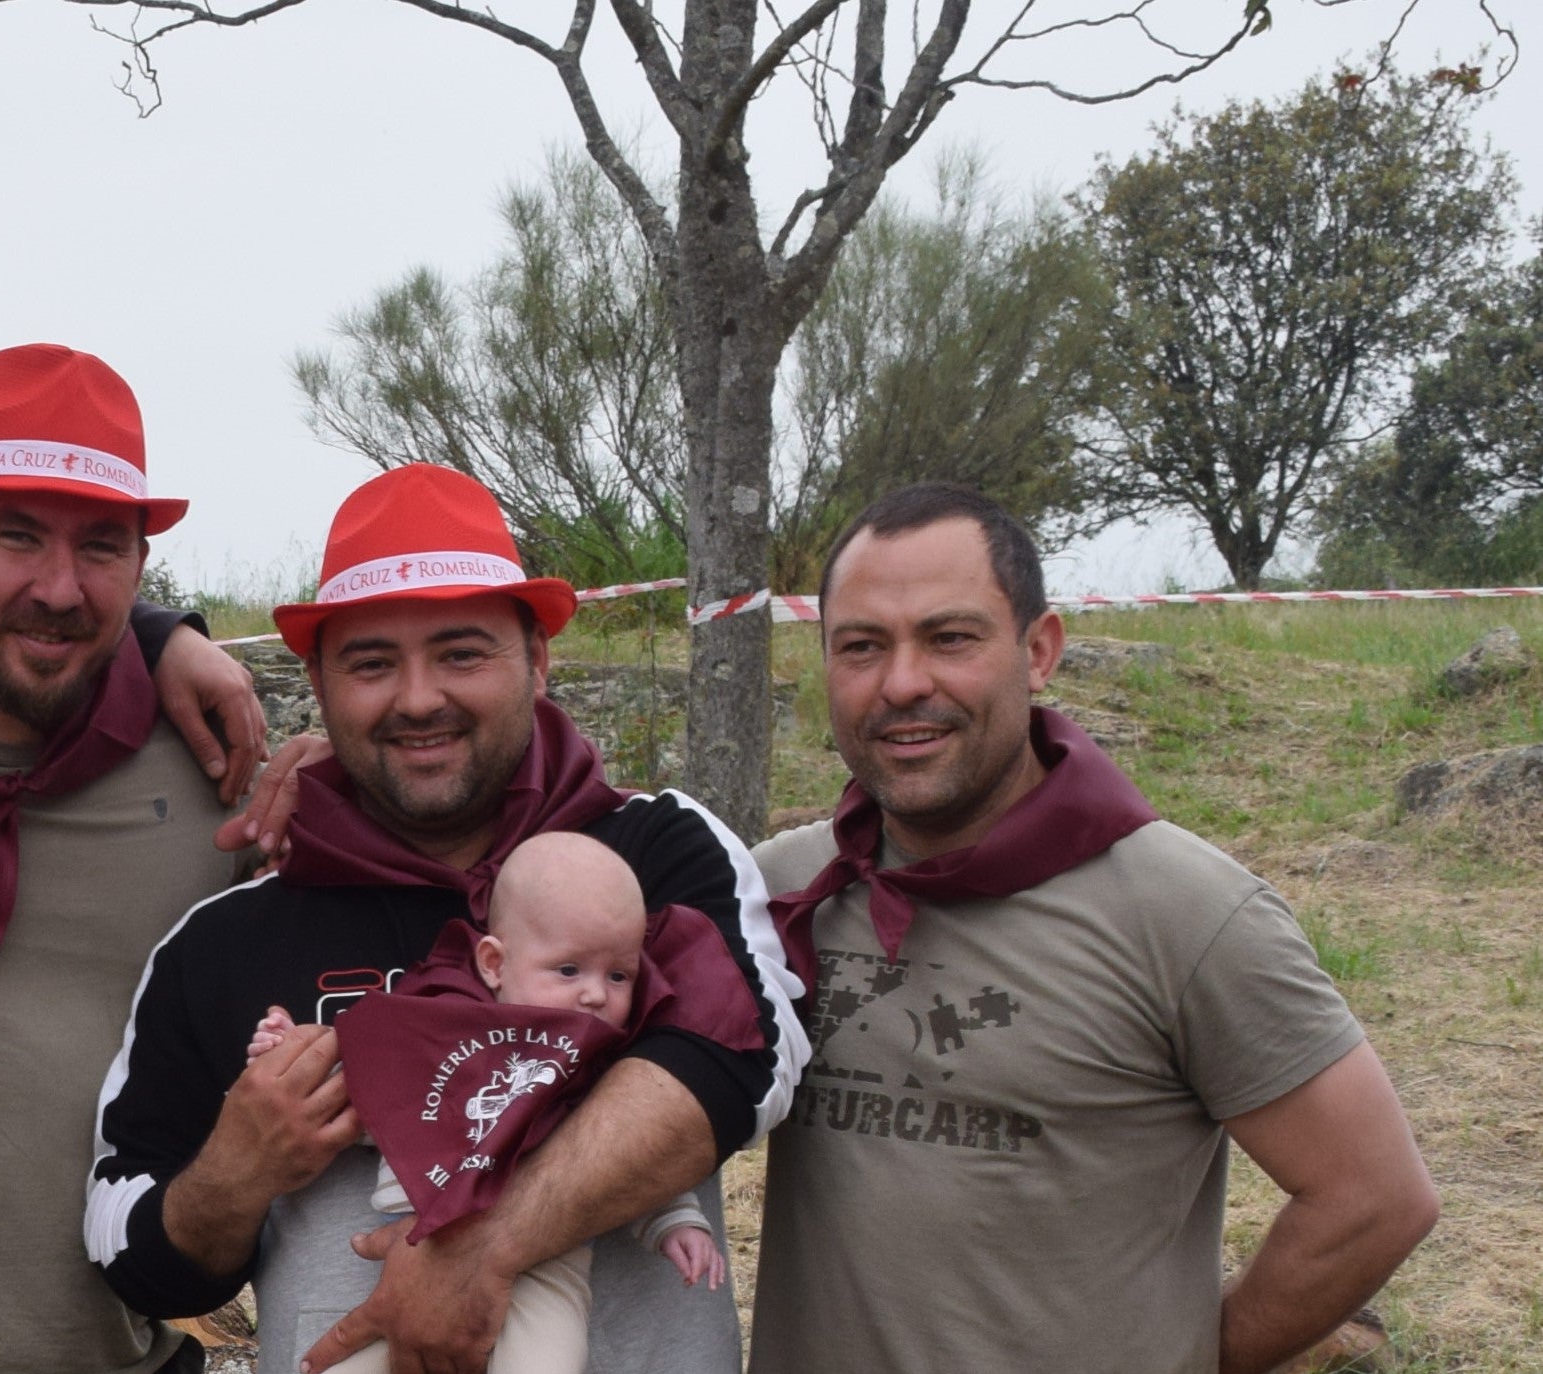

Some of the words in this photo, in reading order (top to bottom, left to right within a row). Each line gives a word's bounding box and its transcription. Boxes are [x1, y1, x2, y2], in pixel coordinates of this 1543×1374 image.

[11, 449, 57, 469] CRUZ
[350, 568, 392, 591] CRUZ
[487, 1027, 518, 1046] DE
[525, 1028, 549, 1046] LA
[552, 1035, 581, 1073] SAN
